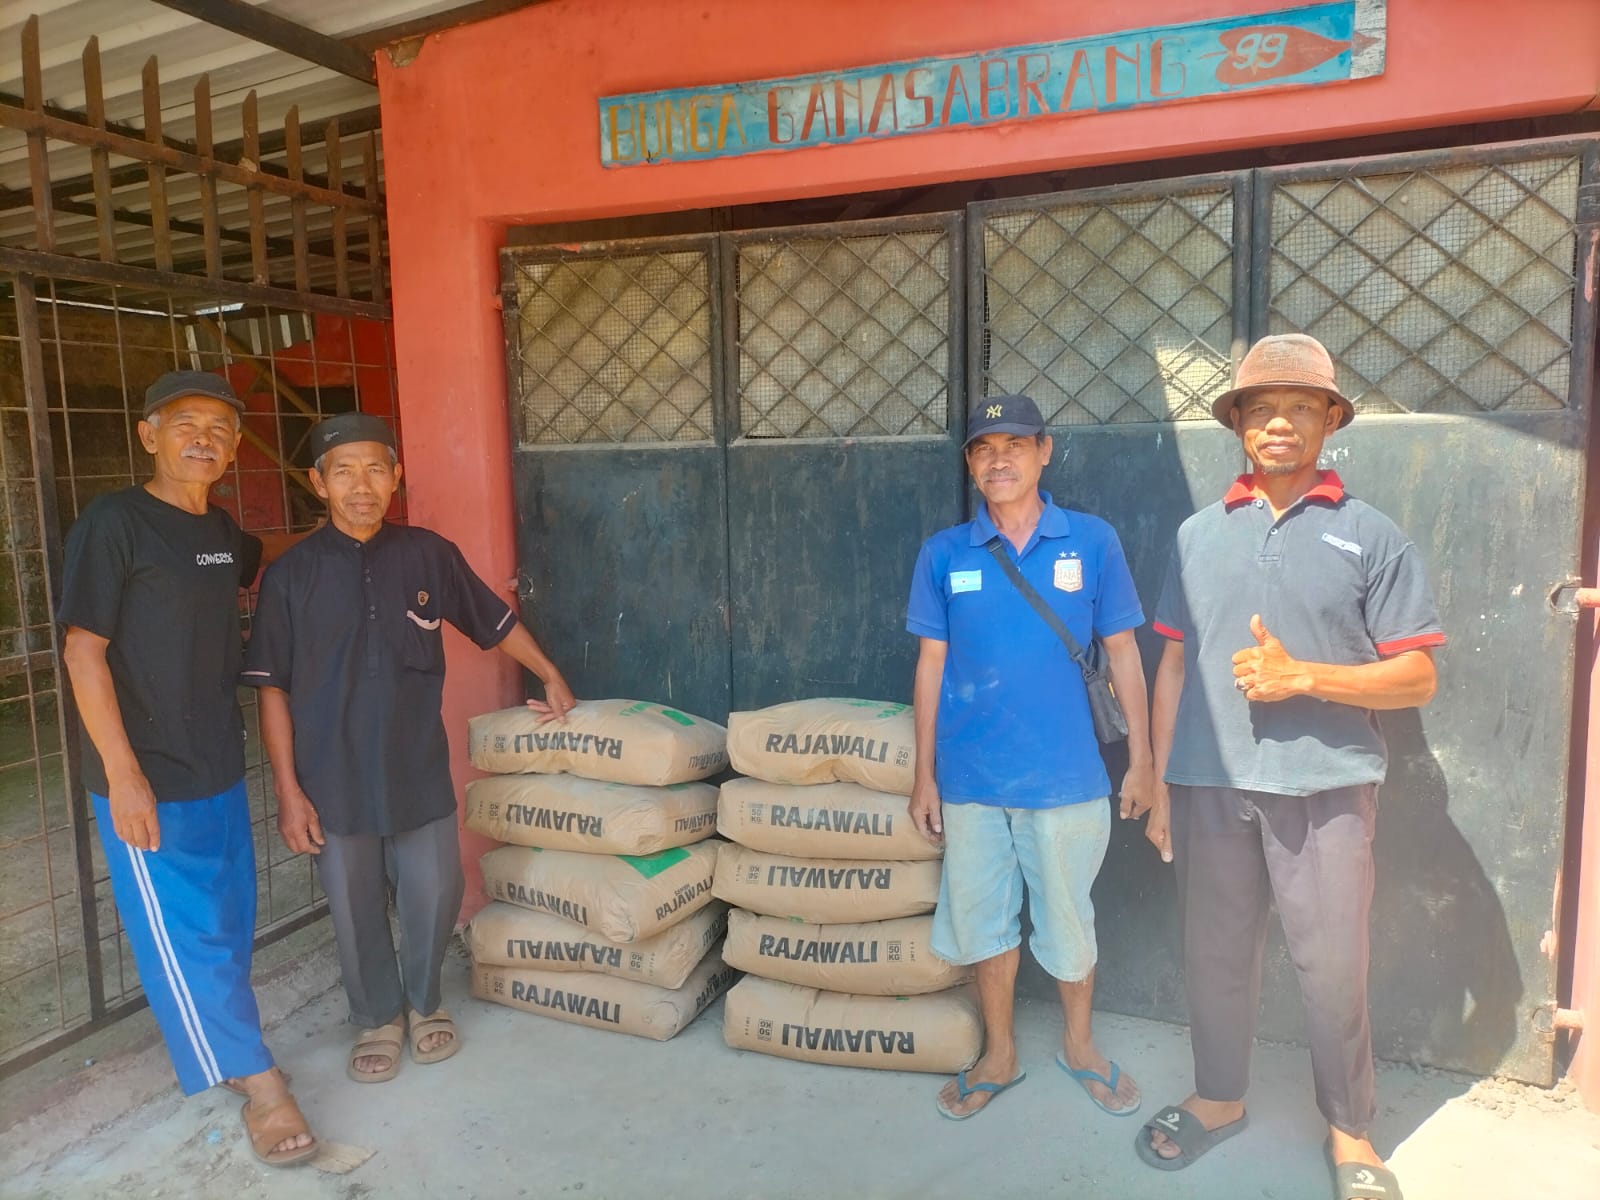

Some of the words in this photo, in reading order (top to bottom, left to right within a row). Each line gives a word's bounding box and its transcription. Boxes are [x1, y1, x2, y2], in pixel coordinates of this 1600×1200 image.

[609, 93, 747, 162] BUNGA
[767, 37, 1187, 145] GANASABRANG
[1232, 33, 1289, 71] 99
[986, 404, 1003, 418] NY
[514, 731, 623, 760] RAJAWALI
[765, 733, 889, 763] RAJAWALI
[897, 750, 909, 759] 50
[895, 758, 908, 767] KG
[505, 803, 603, 838] RAJAWALI
[751, 808, 762, 816] 50
[770, 804, 893, 836] RAJAWALI
[767, 865, 892, 890] RAJAWALI
[507, 881, 587, 926] RAJAWALI
[655, 875, 714, 921] RAJAWALI
[507, 939, 623, 969] RAJAWALI
[759, 934, 878, 964] RAJAWALI
[888, 945, 900, 953] 50
[888, 953, 900, 961] KG
[630, 961, 641, 969] 50
[511, 980, 621, 1024] RAJAWALI
[759, 1019, 772, 1028] KG
[759, 1027, 771, 1036] 50
[781, 1023, 915, 1055] RAJAWALI
